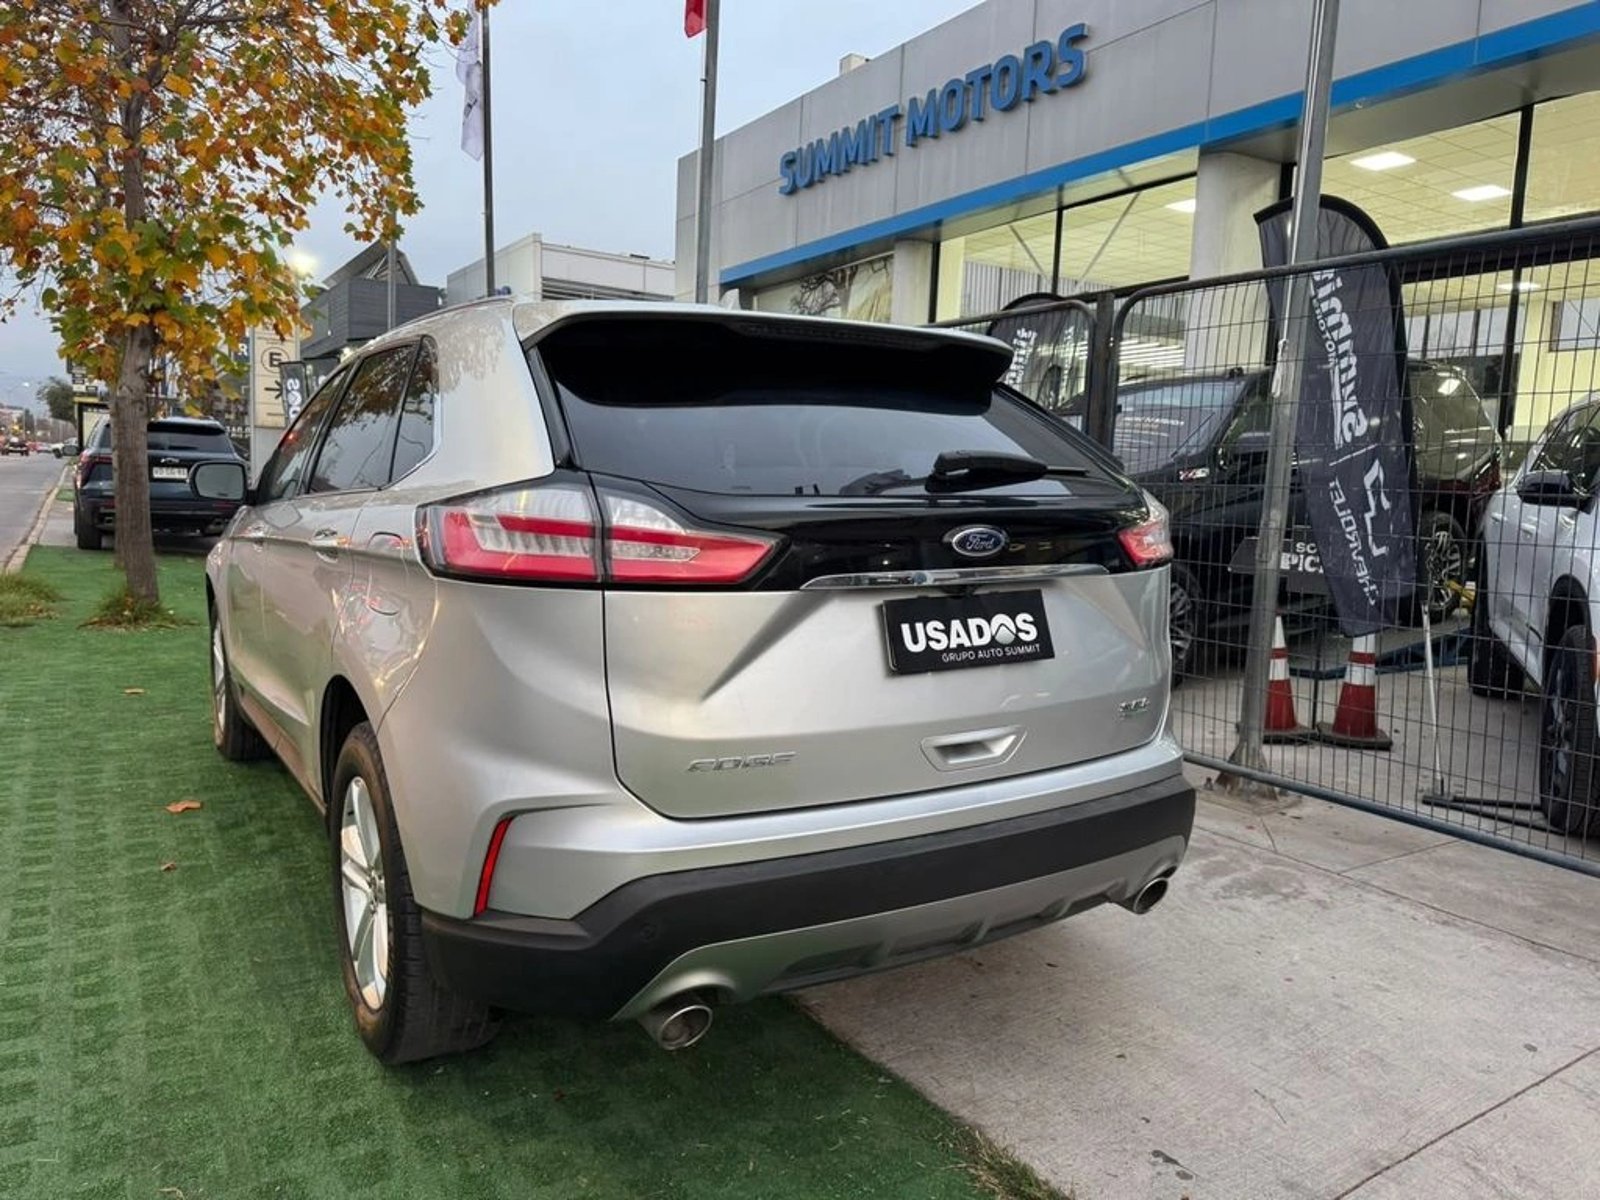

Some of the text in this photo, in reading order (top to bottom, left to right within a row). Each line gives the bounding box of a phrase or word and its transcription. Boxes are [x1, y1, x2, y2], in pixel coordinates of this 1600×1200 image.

[779, 22, 1089, 195] SUMMIT MOTORS
[965, 533, 995, 550] Ford
[901, 612, 1038, 653] USADOS
[942, 643, 1041, 663] GRUPO AUTO SUMMIT
[687, 751, 797, 772] EDGE
